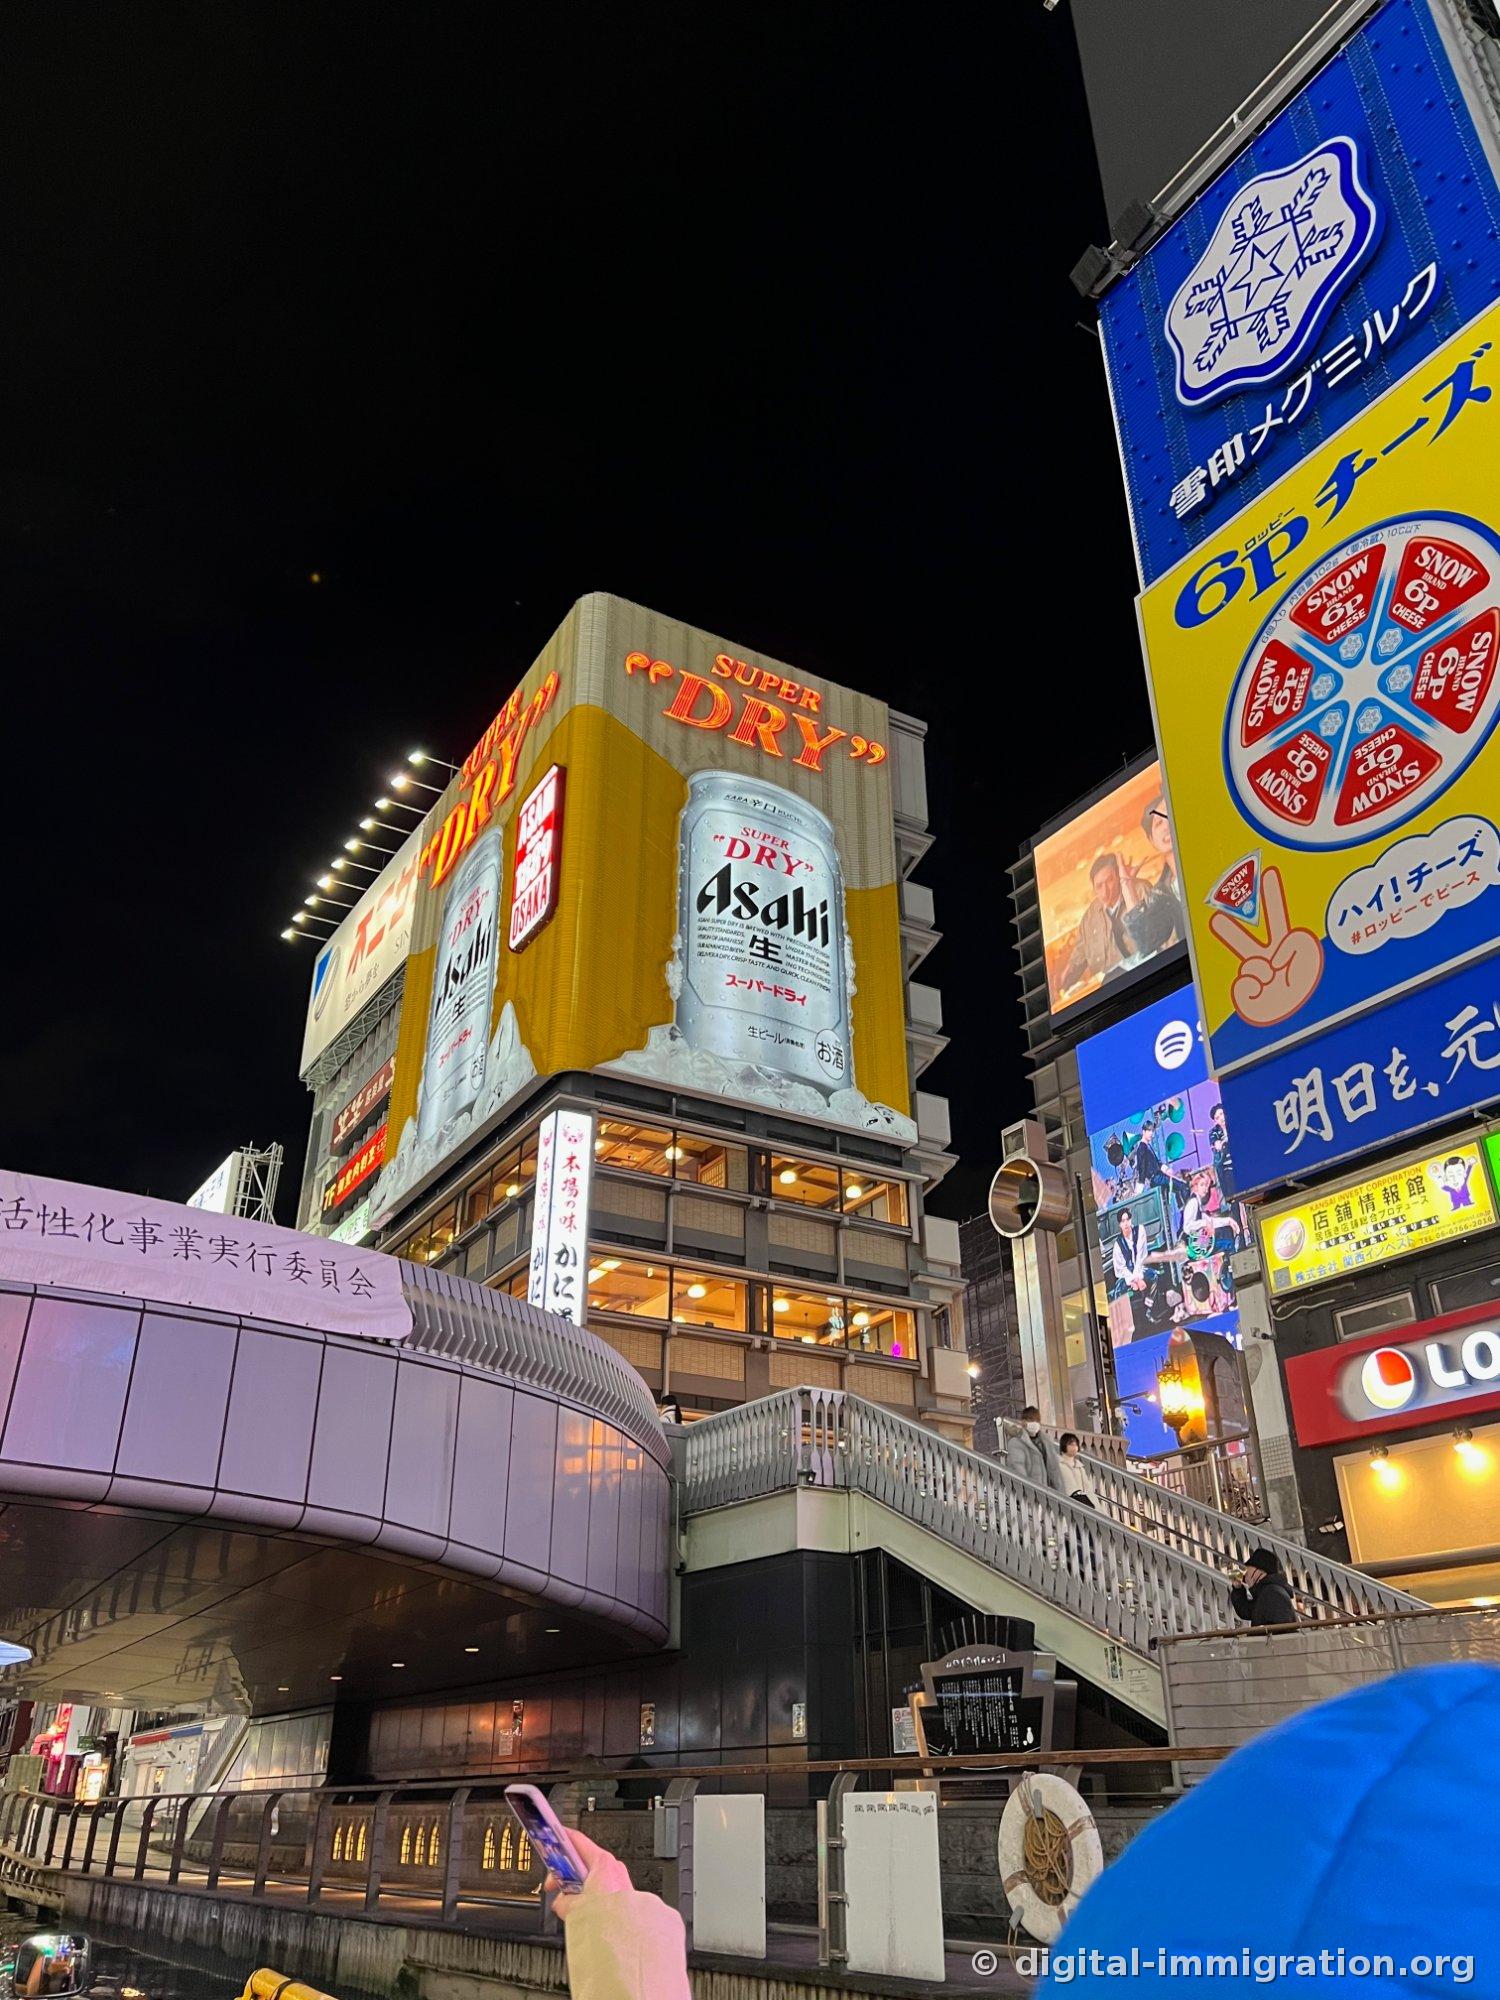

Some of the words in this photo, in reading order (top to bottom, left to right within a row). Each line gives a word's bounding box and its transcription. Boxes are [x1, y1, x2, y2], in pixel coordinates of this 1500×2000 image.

[1168, 261, 1439, 522] 雪印メグミルク
[1245, 506, 1296, 551] ロッピー
[1306, 555, 1369, 614] SNOW
[1414, 546, 1478, 588] SNOW
[1321, 593, 1364, 626] 6P
[1392, 603, 1427, 629] CHEESE
[1404, 579, 1440, 615] 6P
[1326, 608, 1366, 641] CHEESE
[712, 653, 822, 713] SUPER
[1248, 657, 1278, 727] SNOW
[1272, 667, 1299, 715] 6P
[1292, 667, 1311, 711] CHEESE
[1414, 651, 1435, 700] CHEESE
[1428, 647, 1460, 700] 6P
[1455, 631, 1493, 714] SNOW
[625, 651, 887, 771] “DRY”
[459, 688, 523, 791] SUPER
[1298, 733, 1329, 761] CHEESE
[1355, 727, 1397, 760] CHEESE
[1356, 744, 1403, 776] 6P
[1286, 747, 1318, 783] 6P
[1351, 760, 1421, 817] SNOW
[1256, 768, 1308, 815] SNOW
[713, 834, 814, 878] “DRY”
[741, 826, 790, 850] SUPER
[1221, 865, 1249, 895] SNOW
[1338, 829, 1484, 926] ハイ！チーズ
[512, 874, 548, 941] OSAKA
[696, 863, 830, 948] Asahi
[1351, 871, 1480, 945] #ロッピーでピース
[434, 911, 494, 1019] Asahi
[749, 934, 783, 965] 生
[725, 974, 807, 1006] スーパードライ
[817, 1040, 844, 1070] お酒
[1273, 1000, 1500, 1155] 明日を、元
[558, 1151, 581, 1234] 本場の味
[1312, 1175, 1426, 1231] 店舗情報館
